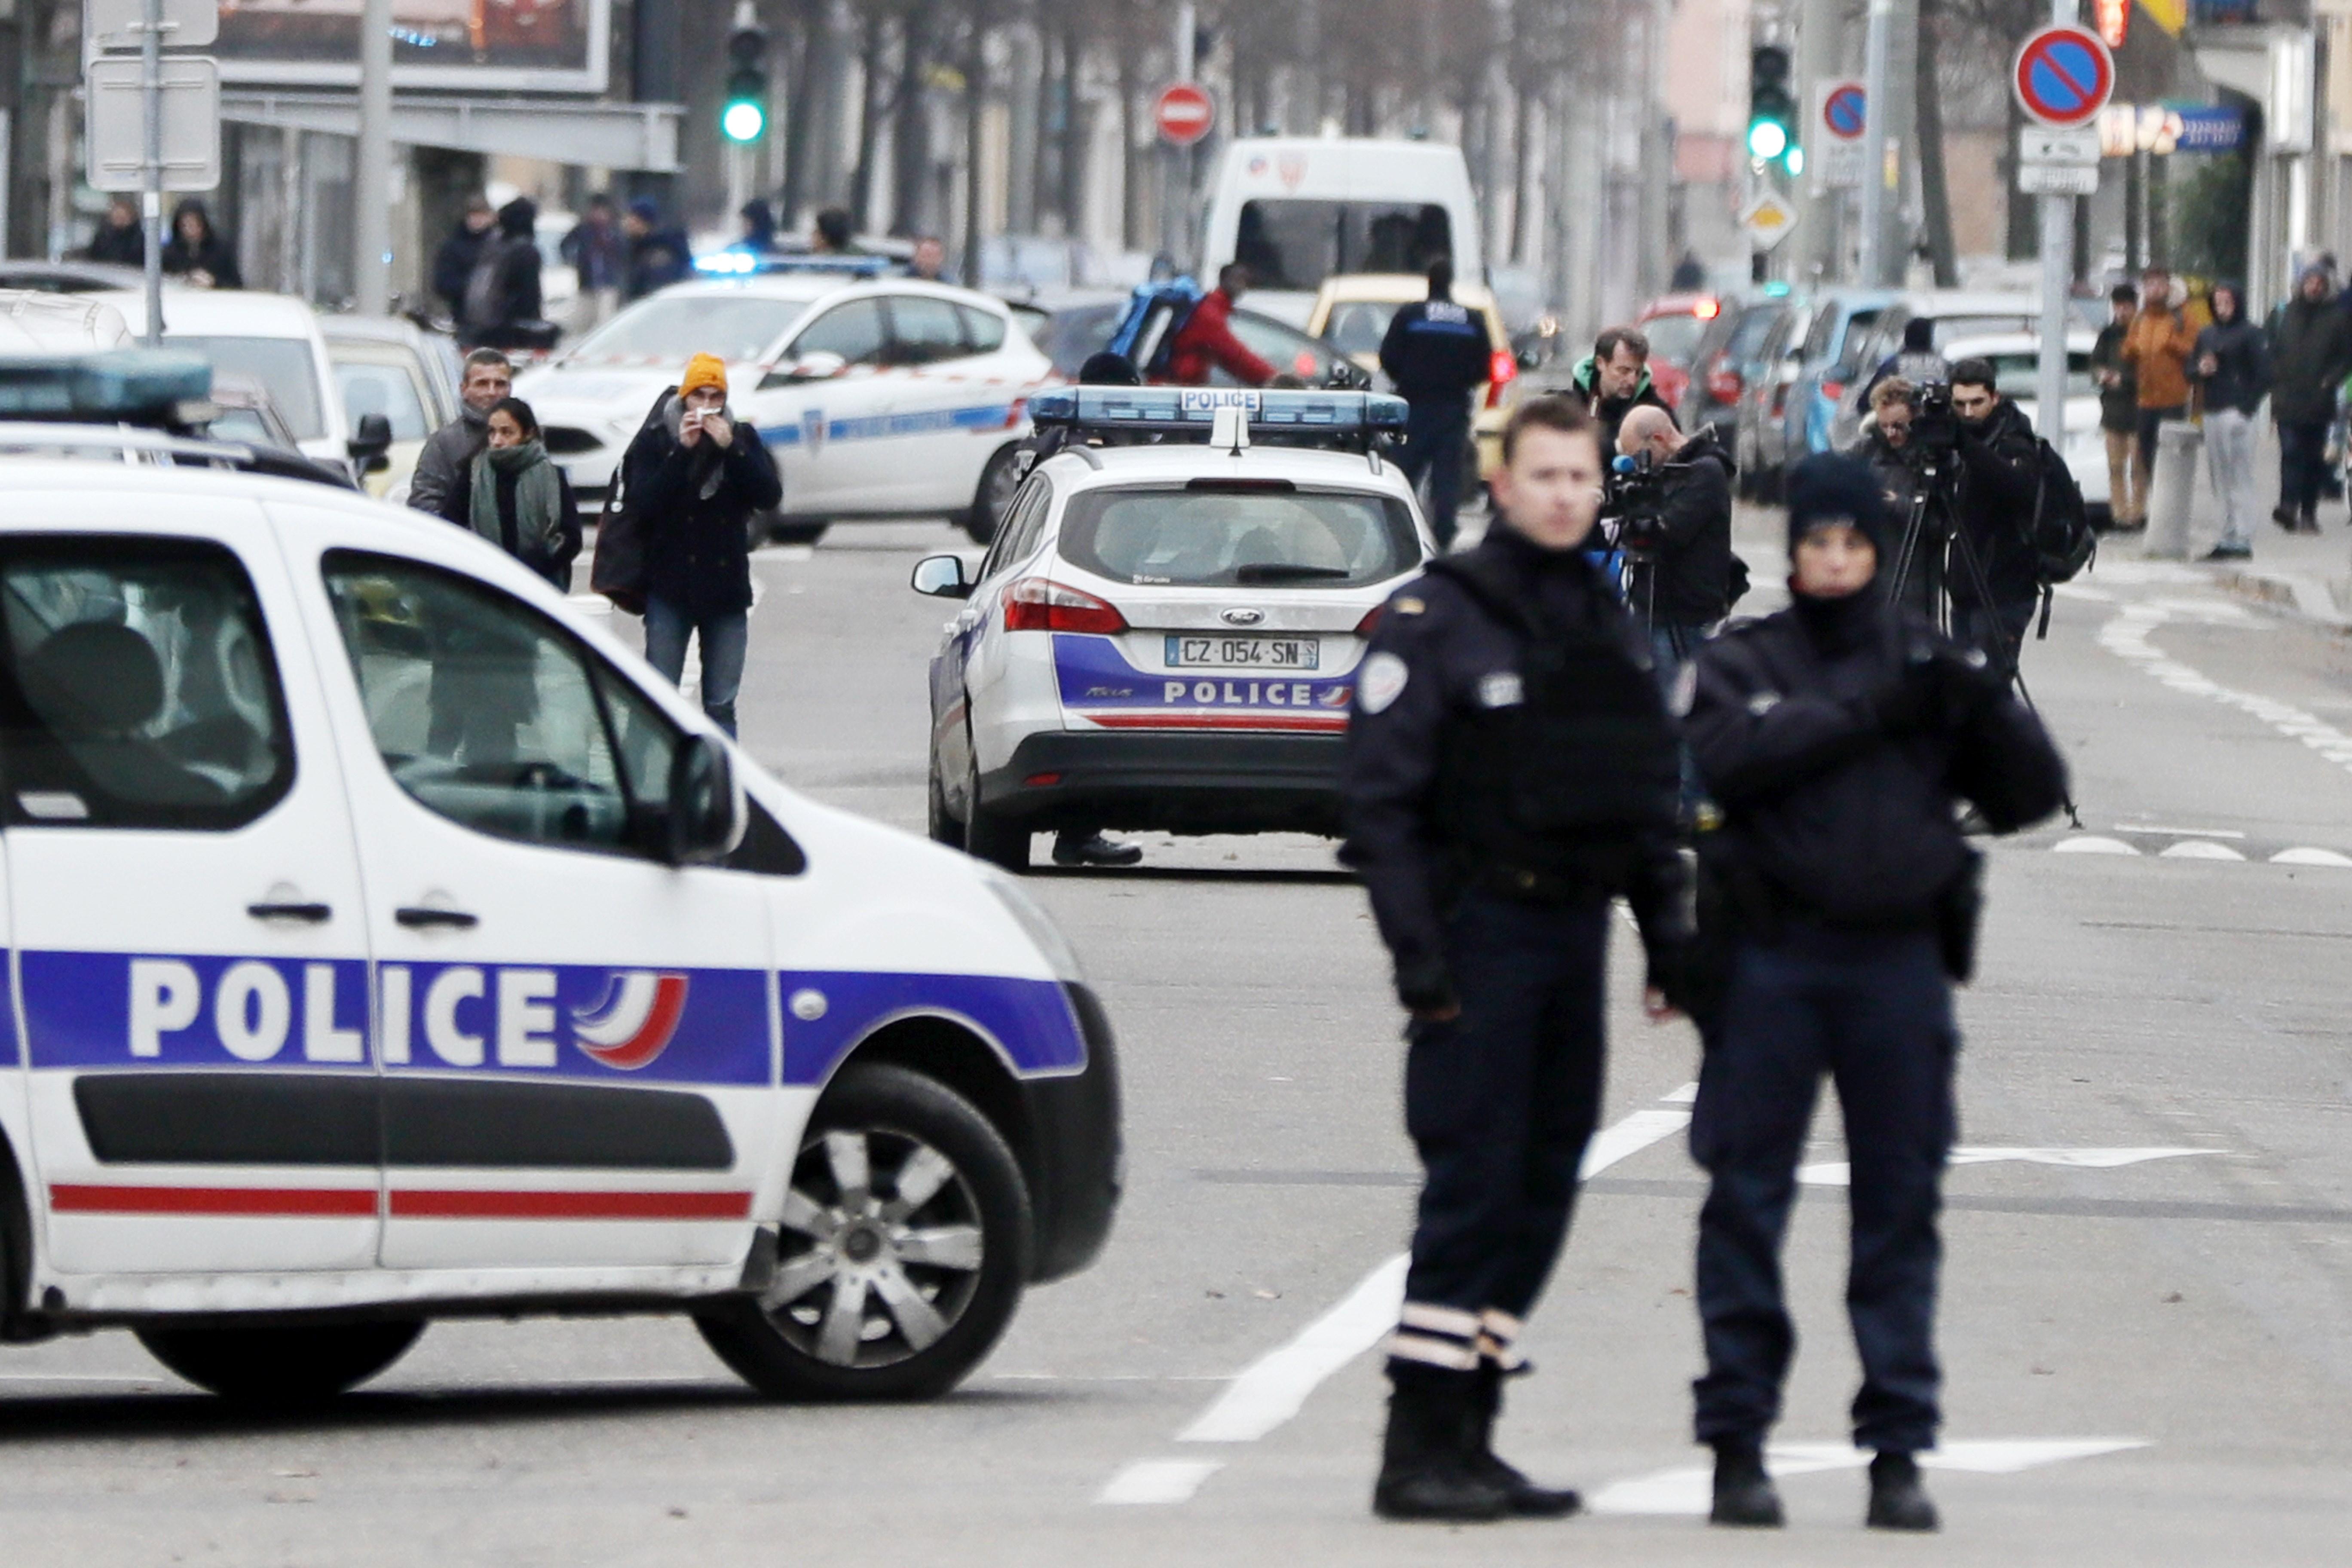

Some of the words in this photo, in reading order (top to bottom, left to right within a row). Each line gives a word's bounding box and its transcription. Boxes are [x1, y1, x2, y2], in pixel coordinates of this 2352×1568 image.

[1185, 392, 1257, 409] POLICE
[1164, 681, 1311, 706] POLICE
[128, 958, 558, 1068] POLICE
